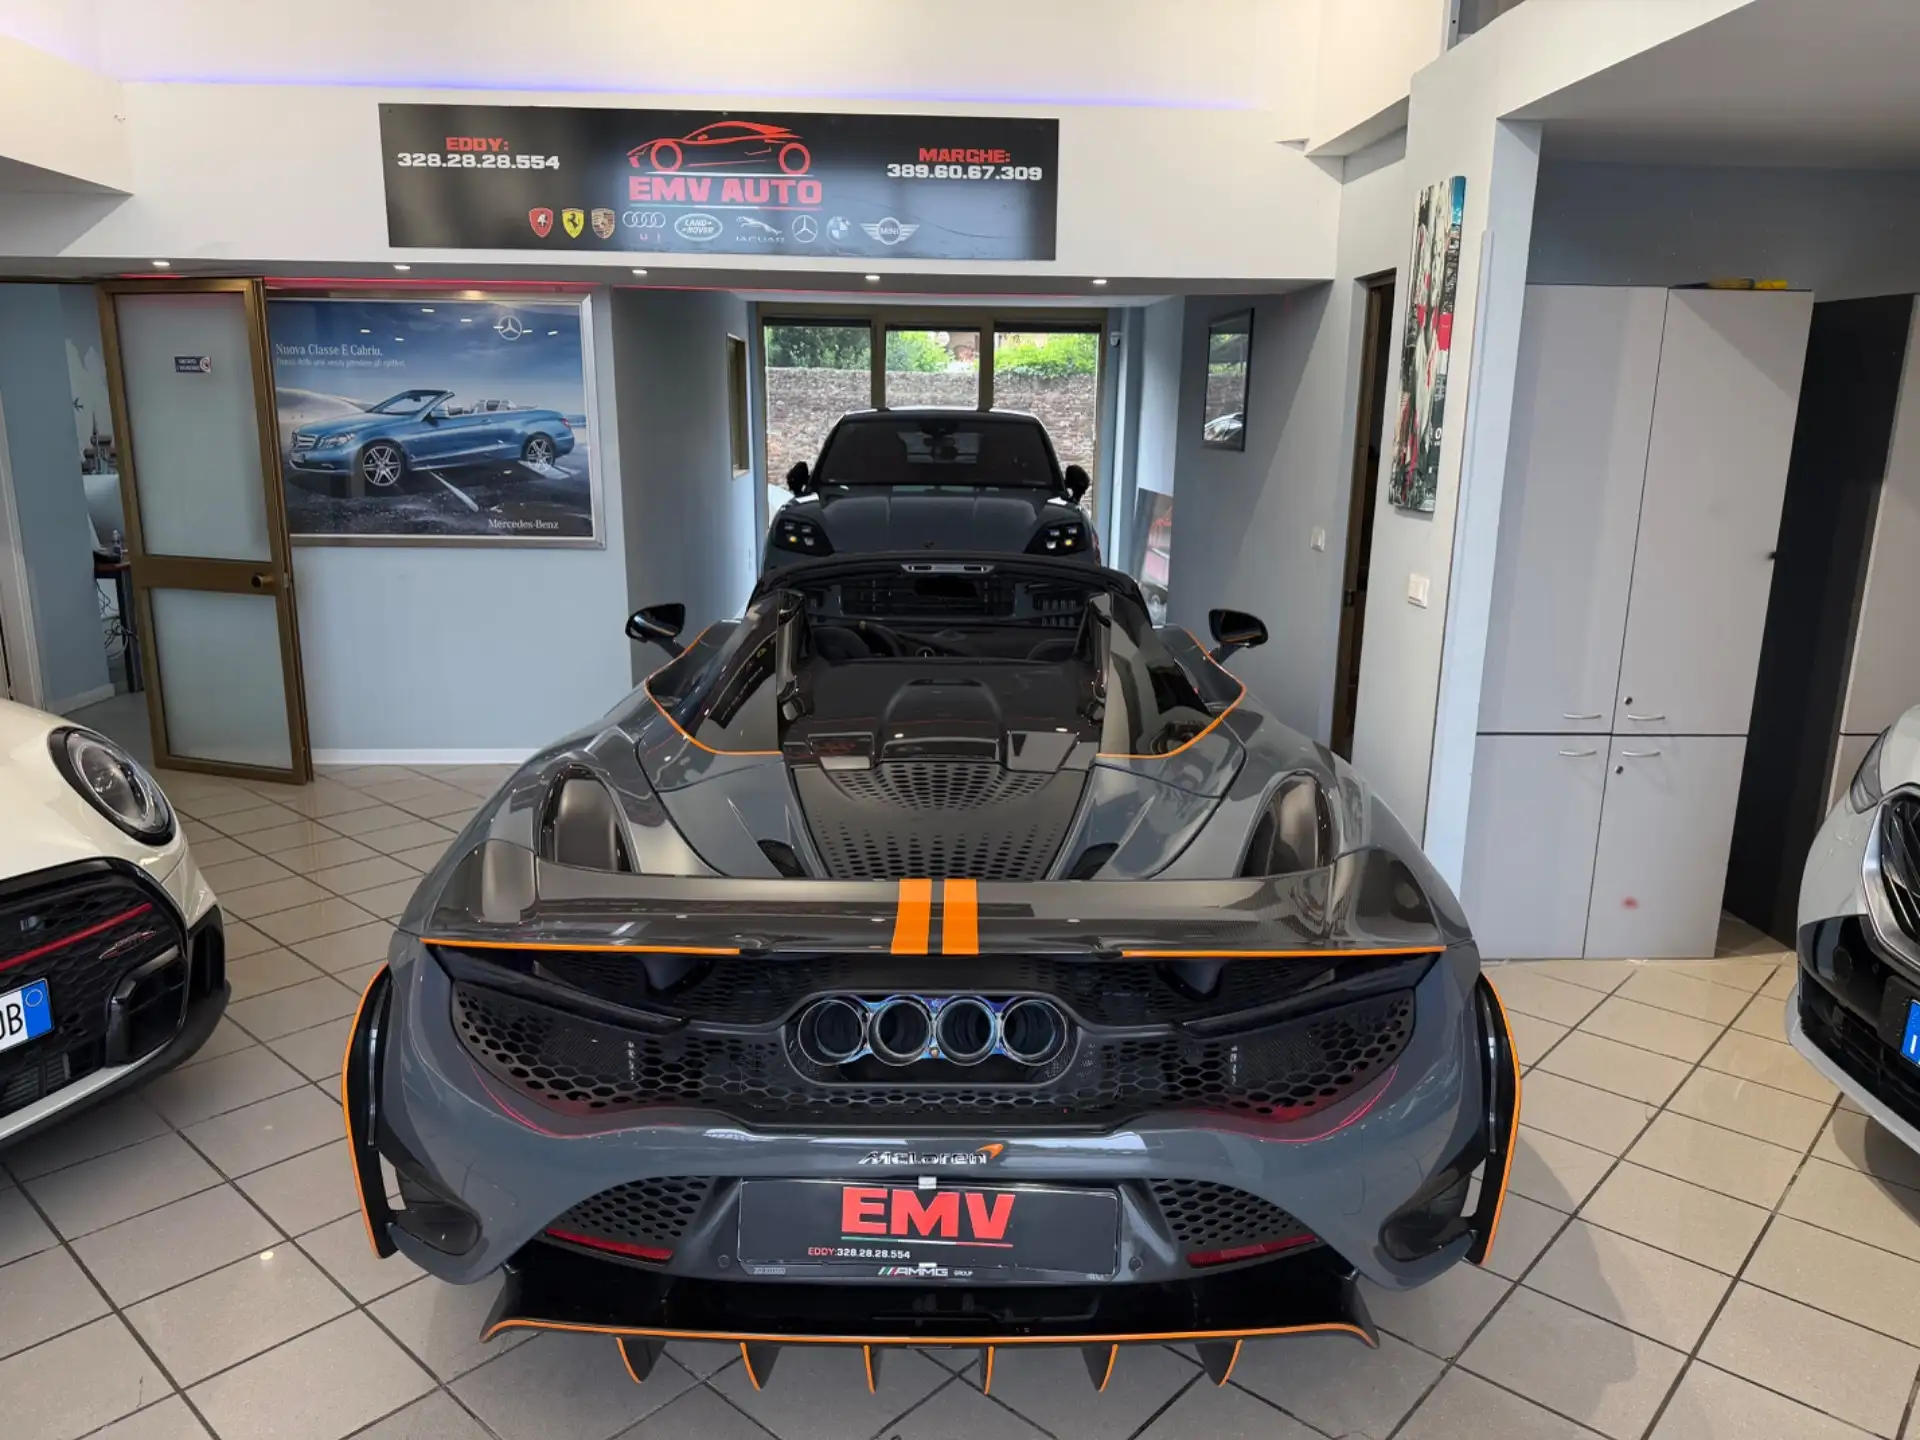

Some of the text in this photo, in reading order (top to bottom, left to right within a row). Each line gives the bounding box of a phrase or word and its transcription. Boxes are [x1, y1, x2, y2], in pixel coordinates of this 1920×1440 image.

[445, 137, 509, 151] EDDY:
[397, 153, 560, 169] 328.28.28.554
[919, 147, 1011, 163] MARCHE:
[887, 163, 1043, 181] 389.60.67.309
[628, 175, 822, 204] EMV AUTO
[308, 343, 339, 356] Classe
[341, 344, 348, 356] E
[488, 518, 559, 529] Mercedes-Benz
[841, 1187, 1016, 1239] EMV
